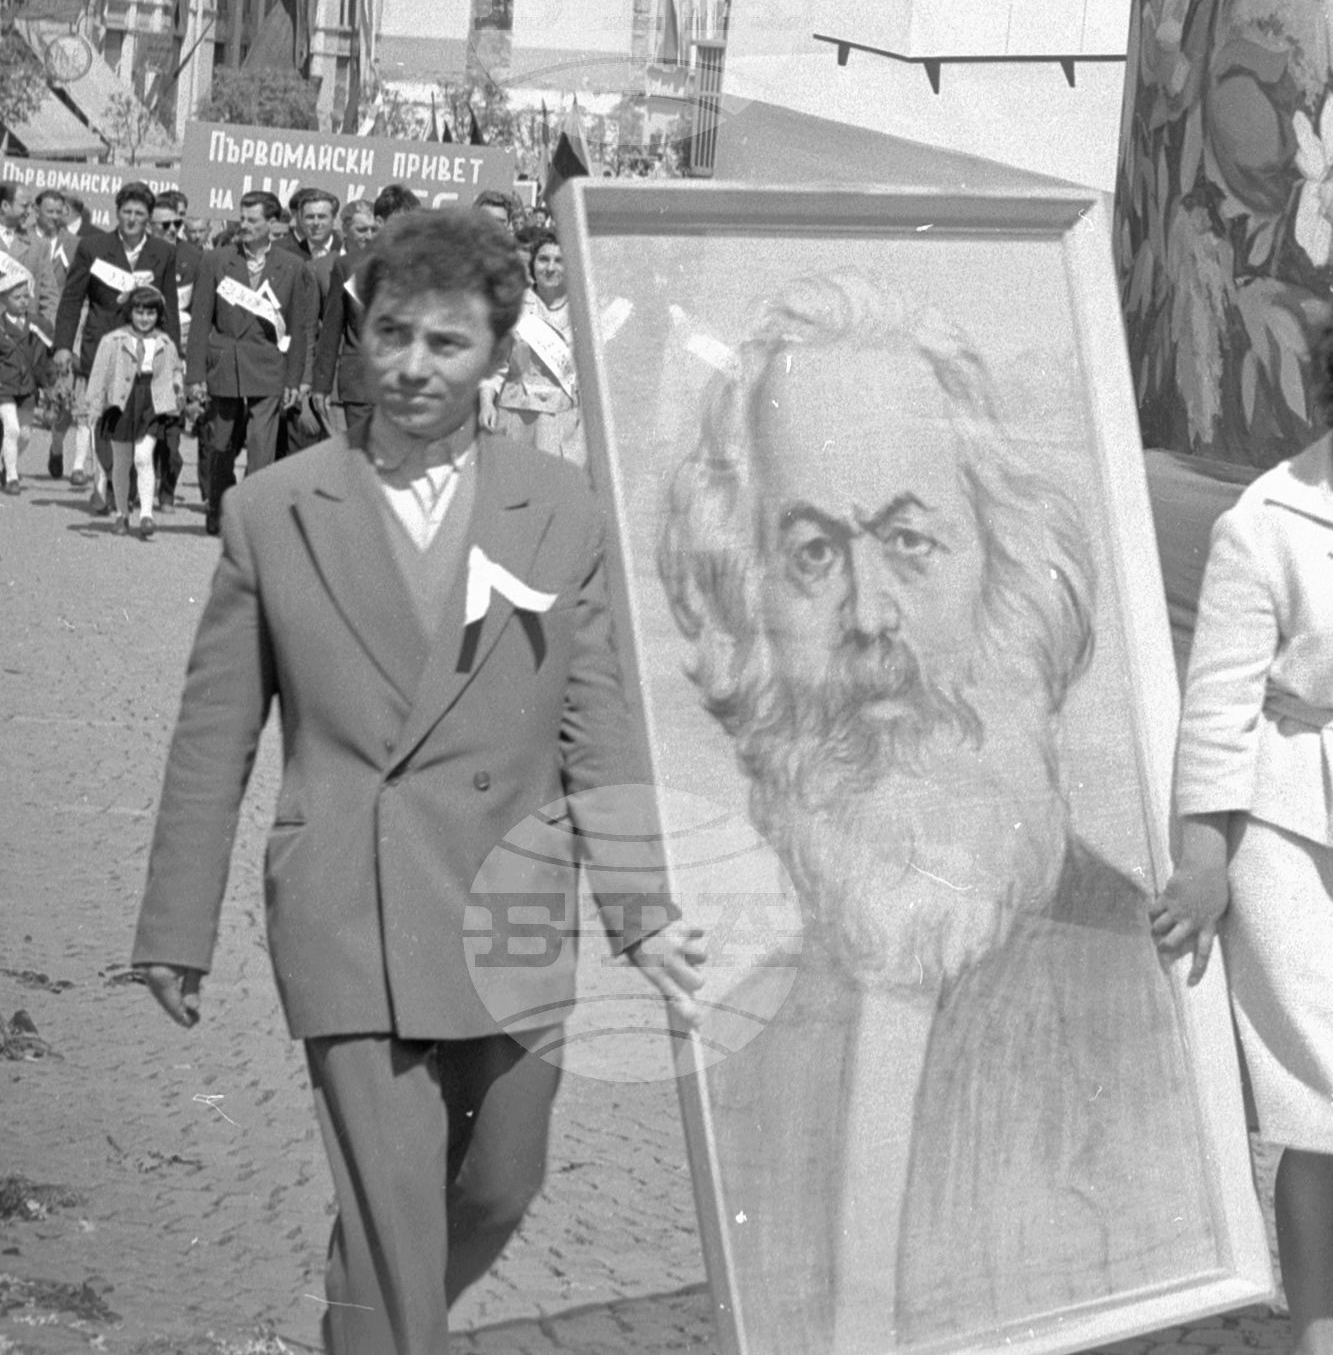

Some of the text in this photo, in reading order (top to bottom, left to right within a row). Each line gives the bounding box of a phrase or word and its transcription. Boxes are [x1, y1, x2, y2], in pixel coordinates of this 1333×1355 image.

[208, 130, 484, 184] ПЪРВОМАЙСКИ ПРИВЕТ
[209, 187, 234, 210] НА
[91, 209, 110, 226] НА
